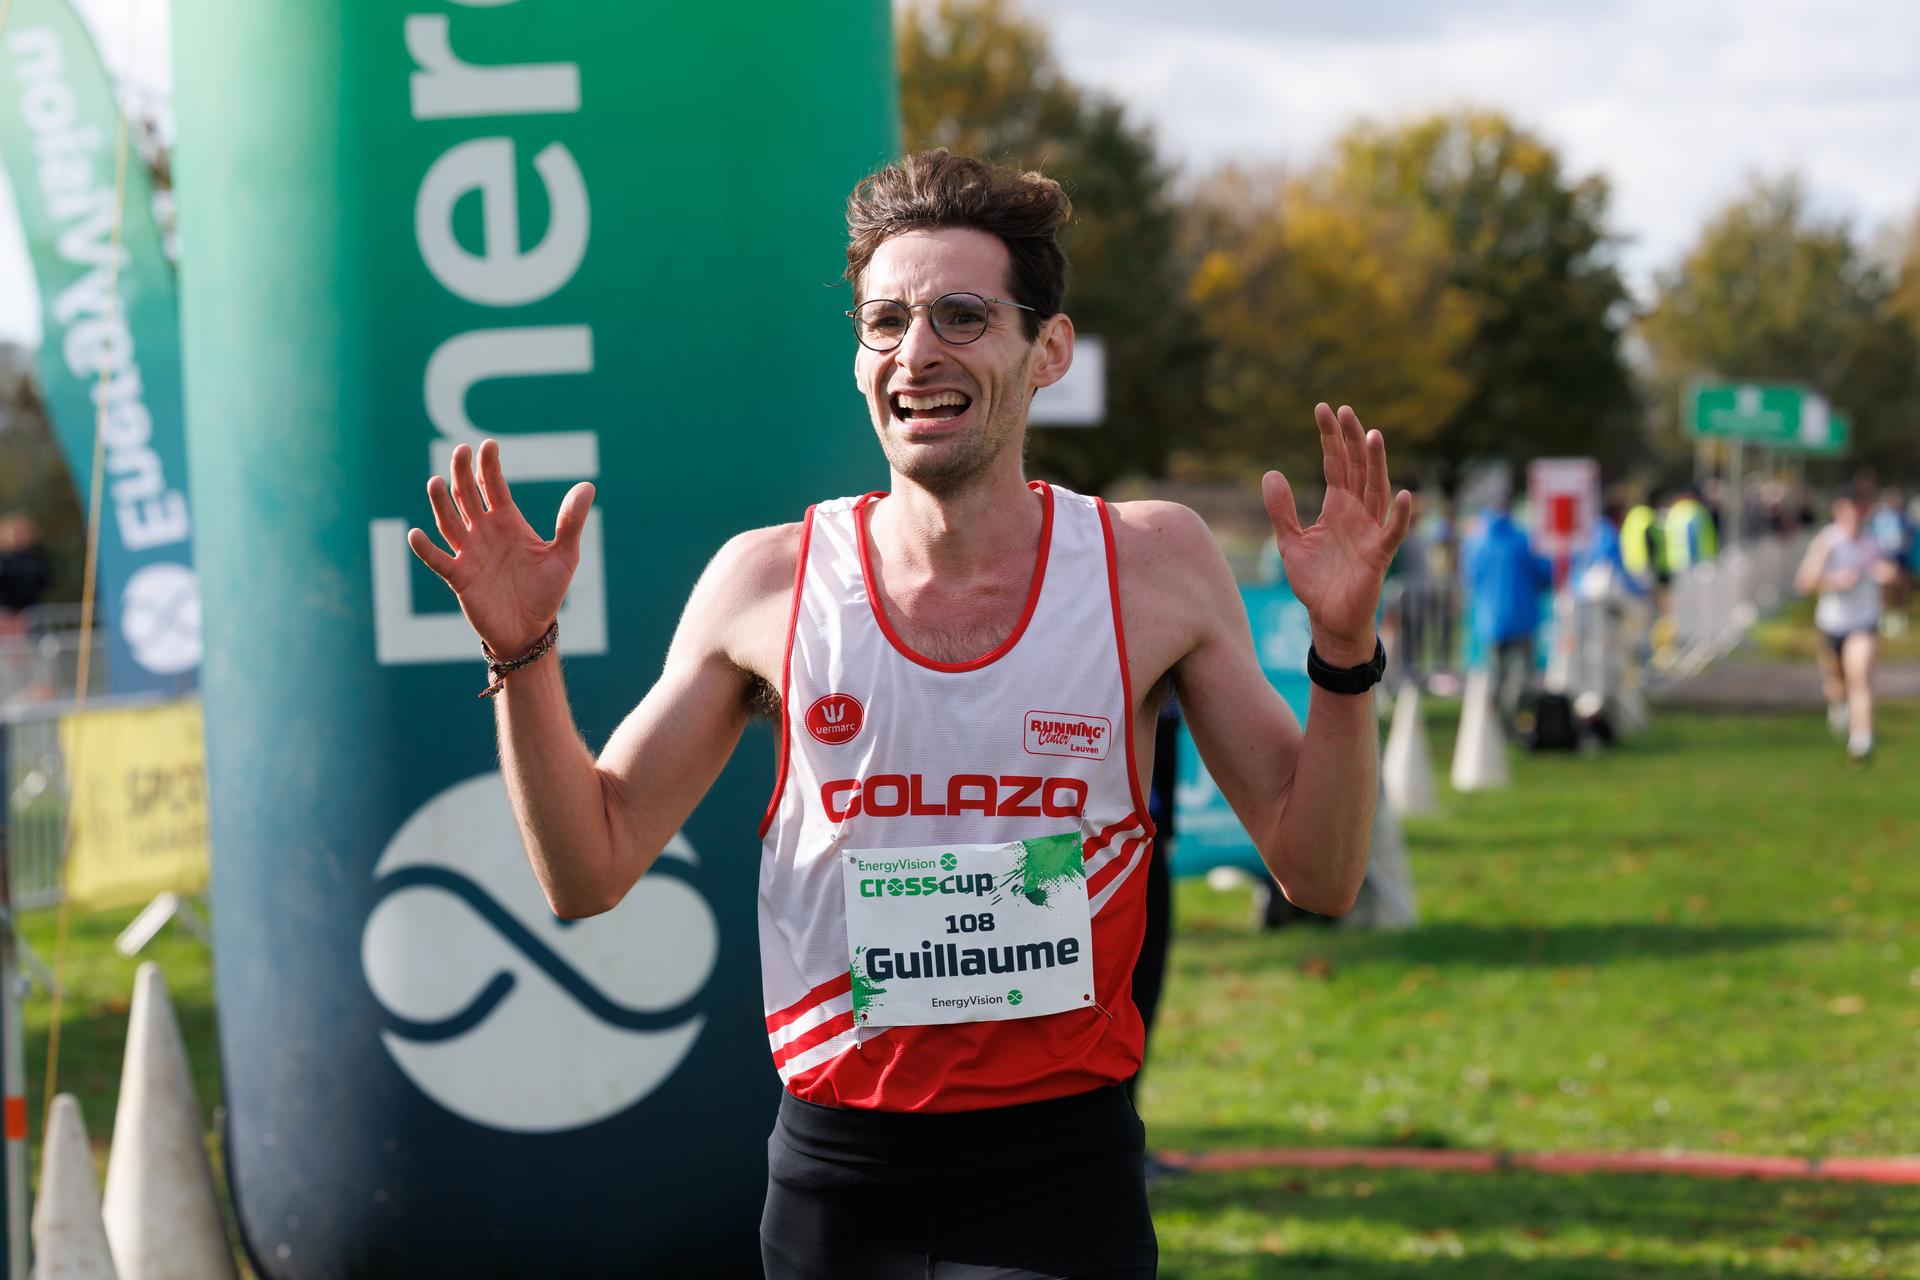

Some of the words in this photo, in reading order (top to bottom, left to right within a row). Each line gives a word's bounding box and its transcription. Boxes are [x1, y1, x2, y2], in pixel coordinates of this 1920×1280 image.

[369, 0, 609, 666] Ener
[815, 723, 856, 735] vermarc
[1038, 728, 1071, 746] Center
[1070, 744, 1099, 755] Leuven
[820, 774, 1088, 821] GOLAZO
[858, 859, 936, 873] EnergyVision
[945, 913, 996, 934] 108
[865, 937, 1078, 980] Guillaume
[931, 995, 1003, 1008] EnergyVision
